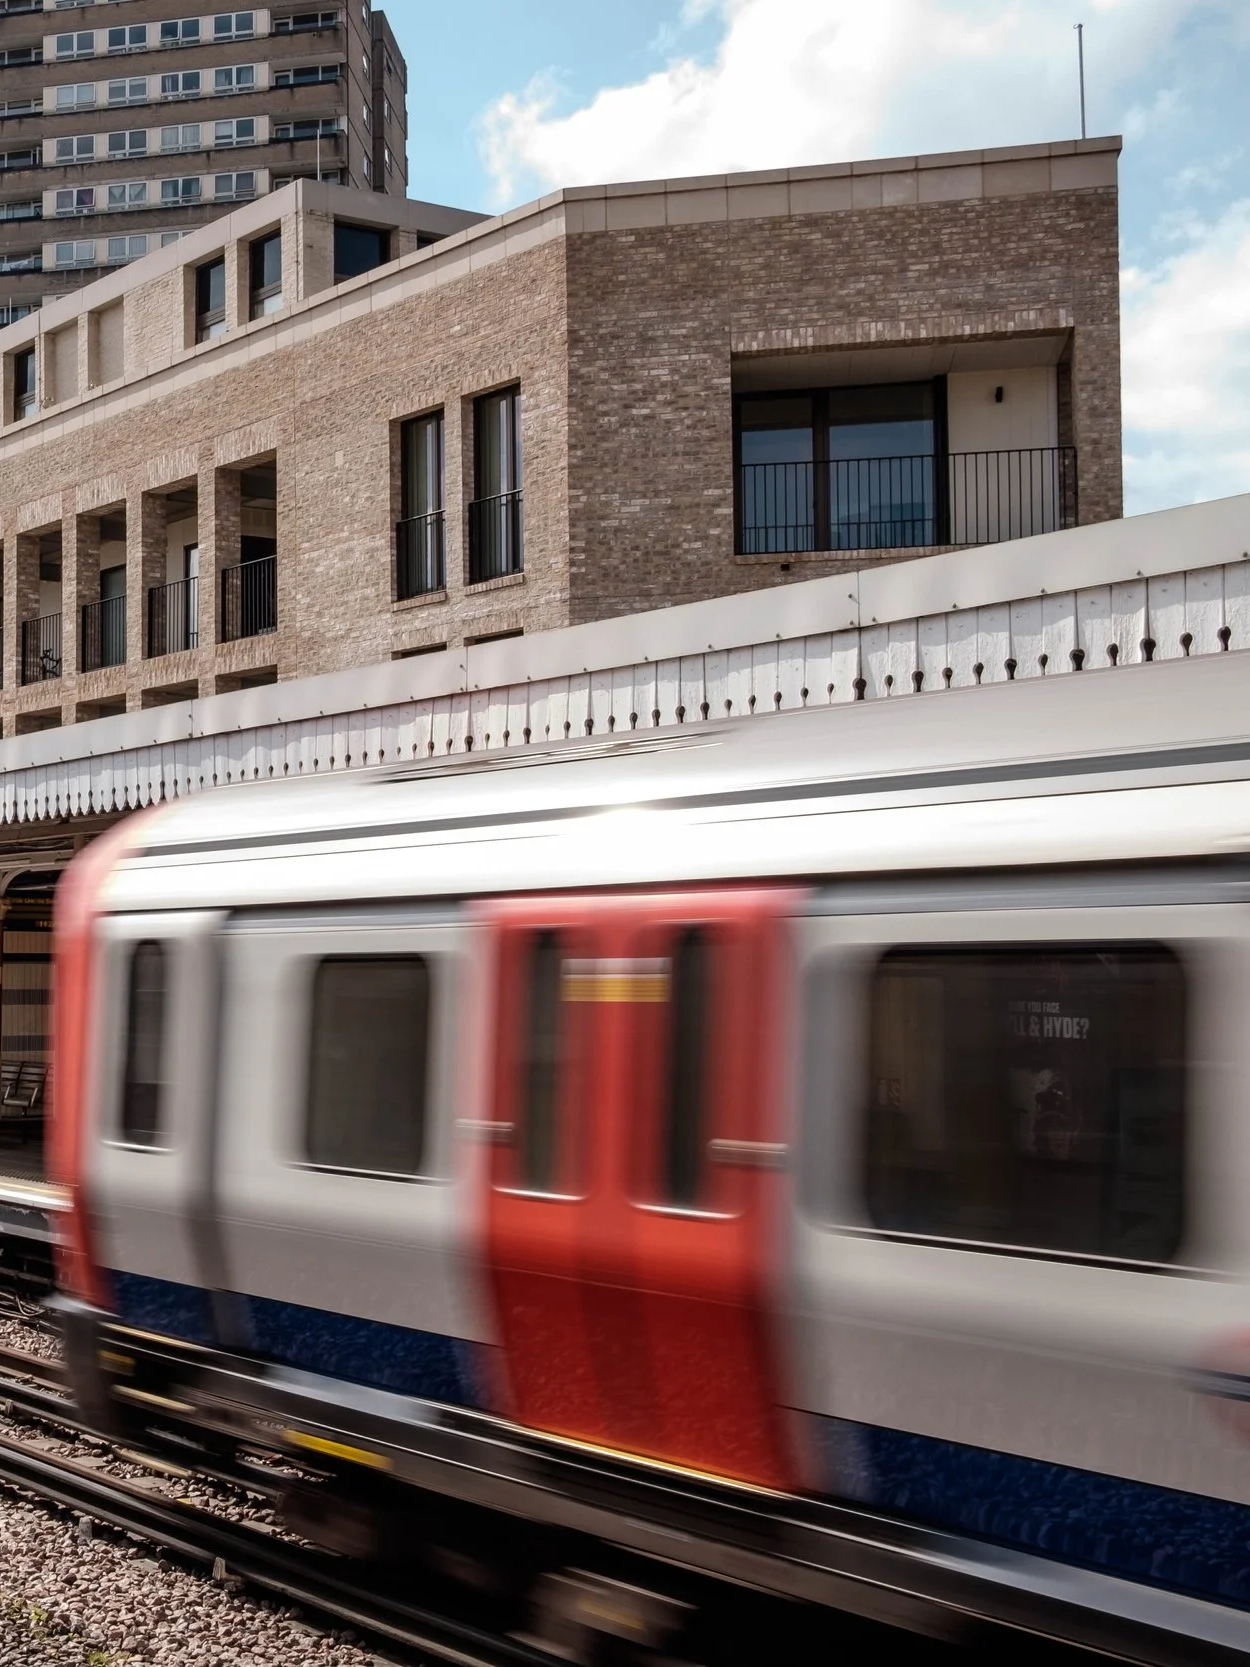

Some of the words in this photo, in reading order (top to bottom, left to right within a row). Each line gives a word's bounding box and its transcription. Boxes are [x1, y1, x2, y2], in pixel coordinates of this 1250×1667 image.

[1042, 1002, 1060, 1013] FACE
[1029, 1015, 1040, 1037] &
[1043, 1016, 1090, 1039] HYDE?
